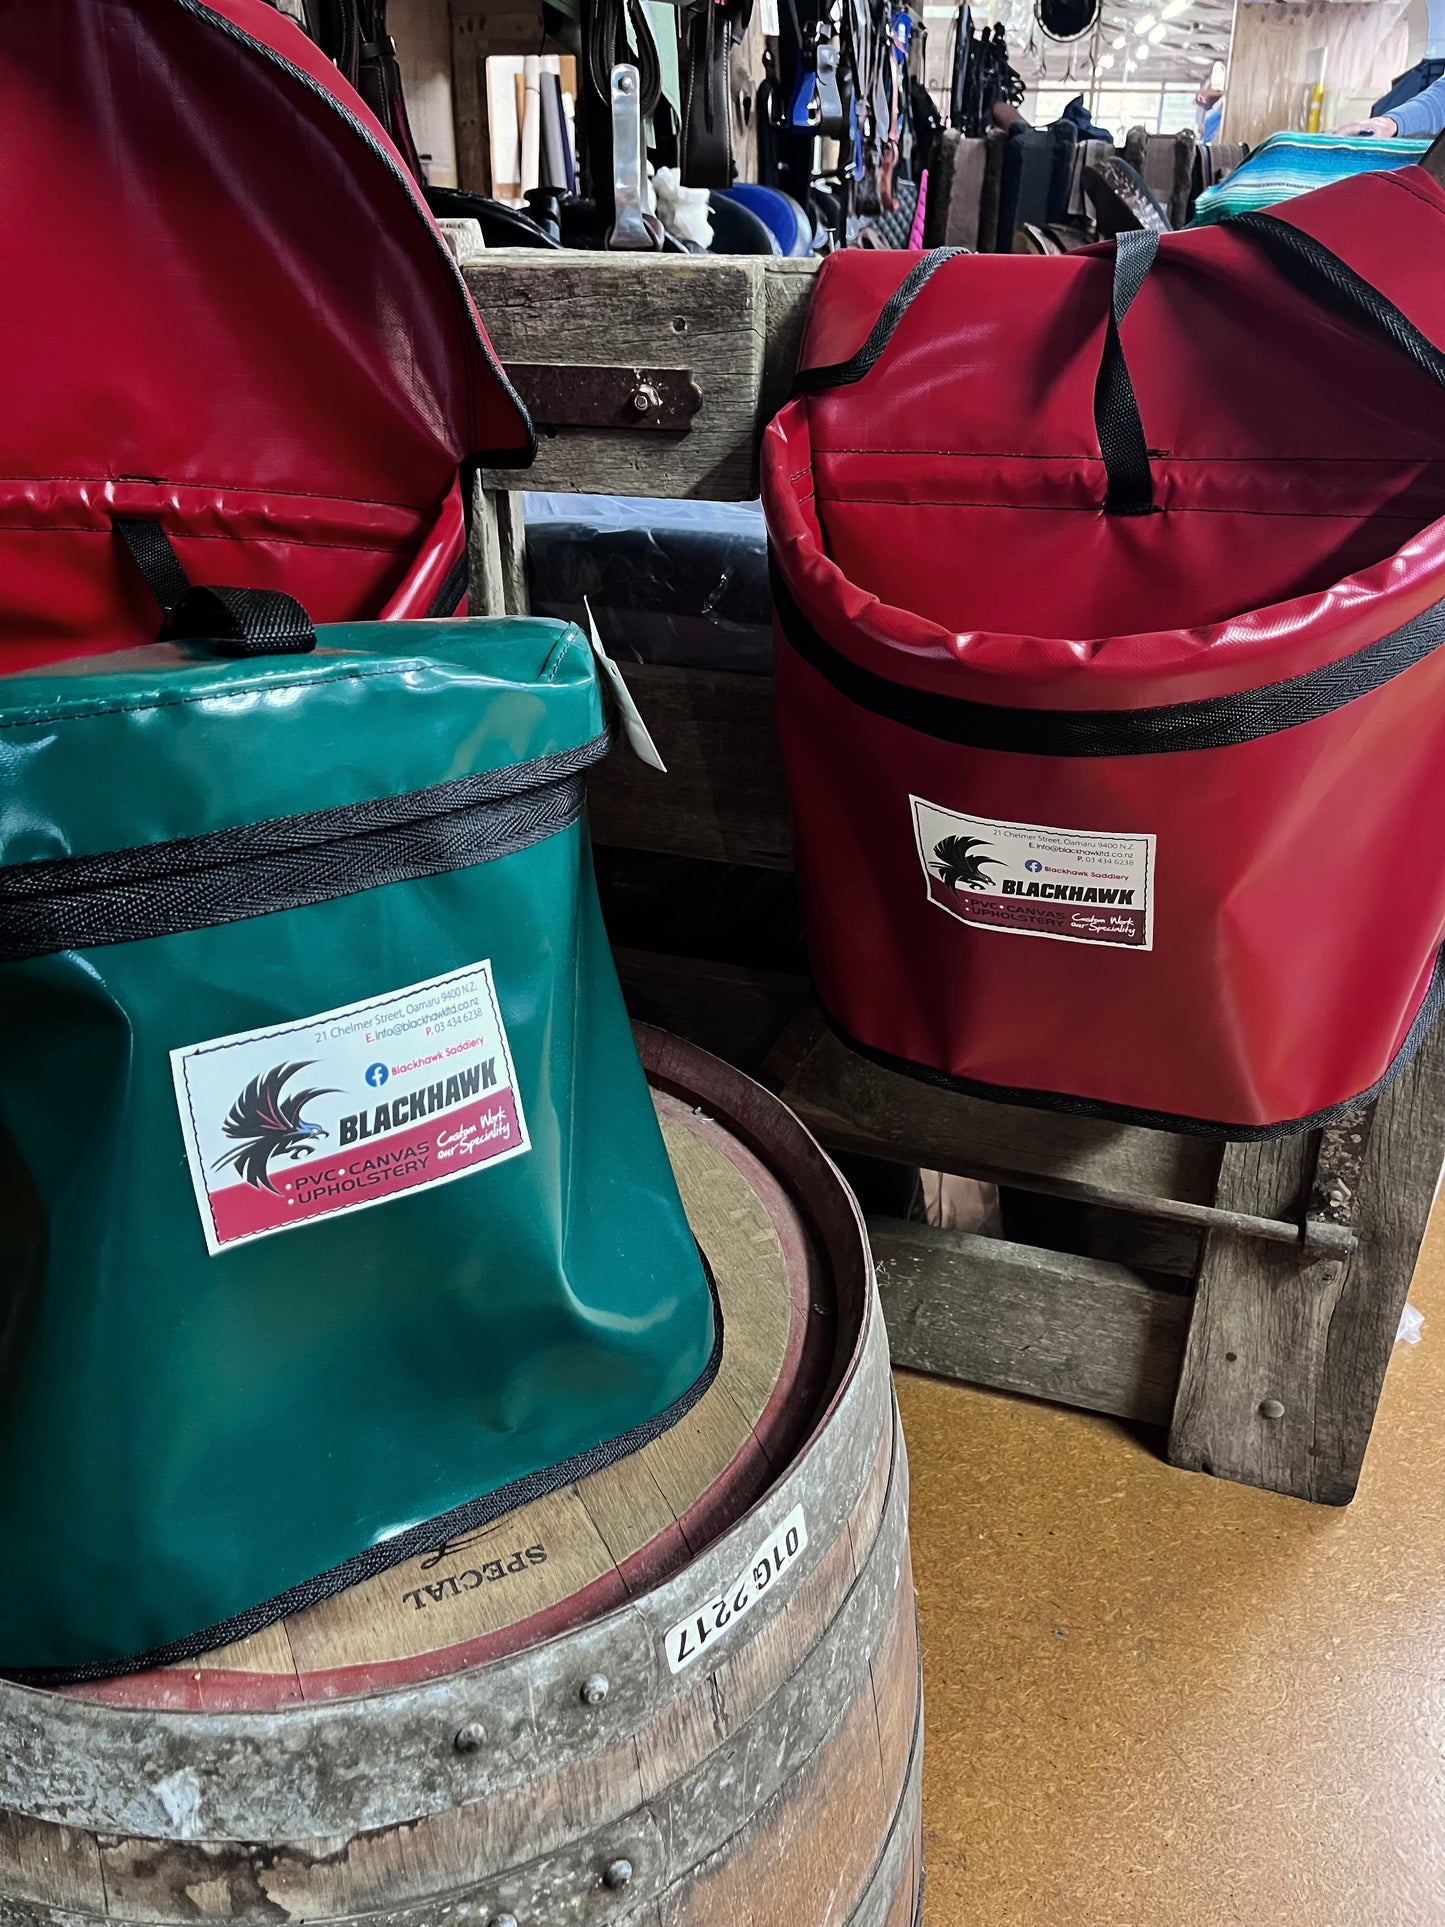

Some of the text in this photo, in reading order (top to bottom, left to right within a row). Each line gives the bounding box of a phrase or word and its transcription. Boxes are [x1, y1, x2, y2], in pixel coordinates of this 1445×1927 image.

[1004, 831, 1037, 841] Chelmer
[1063, 838, 1096, 848] Oamaru
[1098, 841, 1118, 849] 9400
[1044, 866, 1089, 877] Blackhawk
[1091, 871, 1129, 881] Saddlery
[1114, 858, 1134, 866] 6238
[1001, 879, 1136, 905] BLACKHAWK
[971, 907, 1065, 927] UPHOLSTERY
[1006, 905, 1066, 920] CANVAS
[1071, 913, 1134, 926] Custom Work
[1088, 922, 1136, 937] Speciality
[315, 1031, 328, 1043] 21
[330, 1018, 373, 1039] Chelmer
[406, 996, 440, 1015] Oamaru
[440, 986, 461, 1003] 9400
[434, 1022, 446, 1034] 03
[446, 1016, 462, 1030] 434
[463, 1007, 483, 1023] 6238
[391, 1049, 445, 1076] Blackhawk
[445, 1036, 485, 1057] Saddlery
[339, 1056, 498, 1147] BLACKHAWK
[436, 1105, 507, 1148] Custom Work
[459, 1118, 511, 1155] Speciality
[294, 1140, 431, 1191] PVC CANVAS
[297, 1155, 430, 1205] UPHOLSTERY
[402, 1543, 548, 1610] SPECIAL
[677, 1580, 749, 1663] 2217
